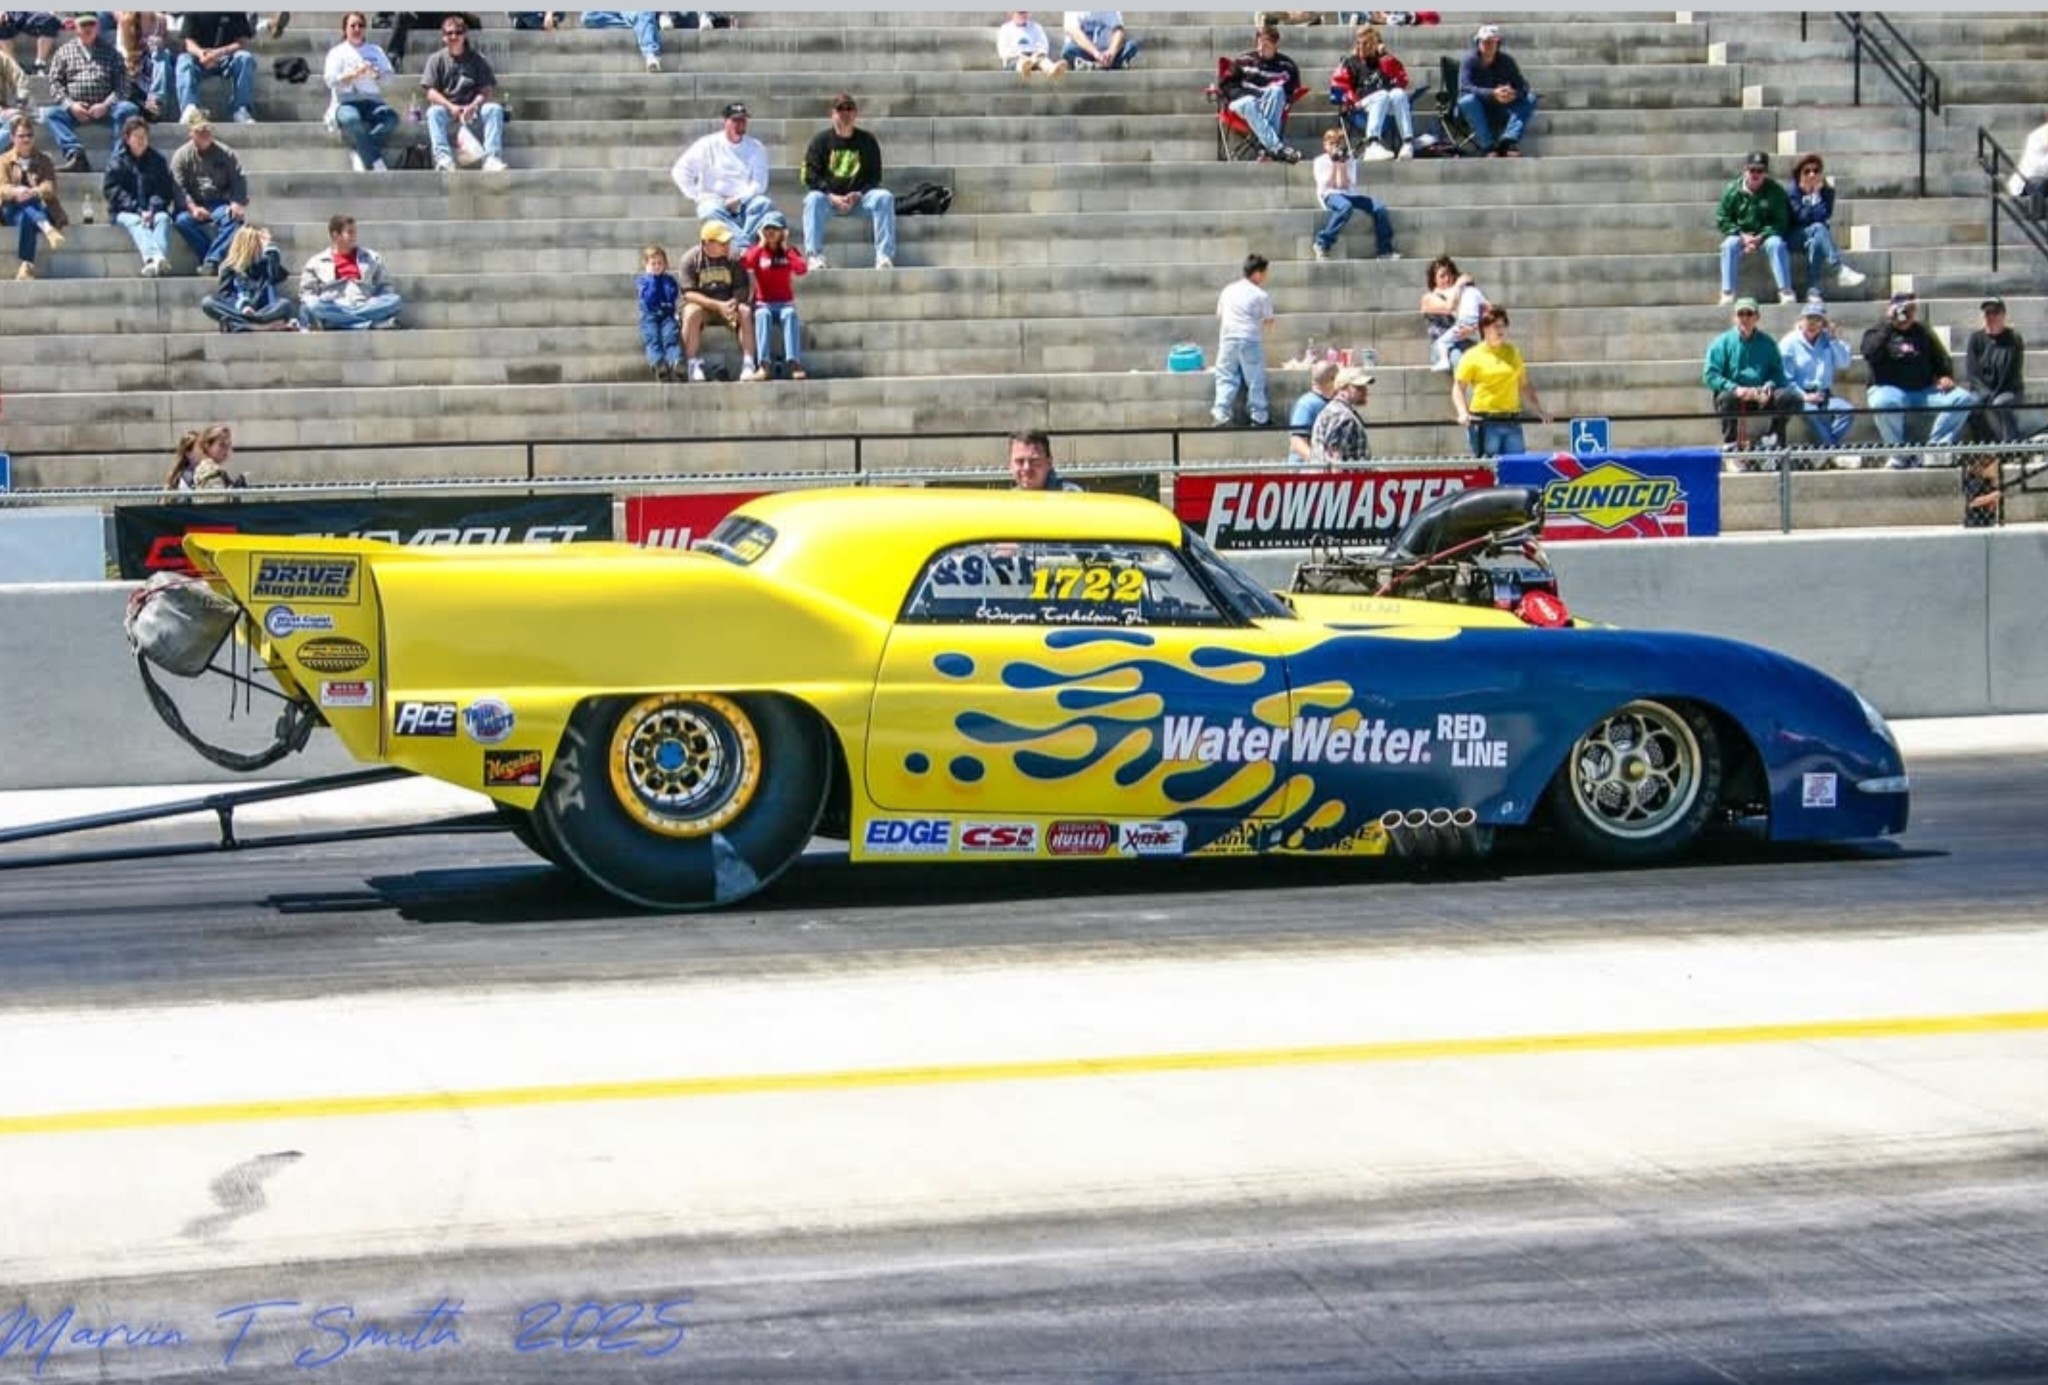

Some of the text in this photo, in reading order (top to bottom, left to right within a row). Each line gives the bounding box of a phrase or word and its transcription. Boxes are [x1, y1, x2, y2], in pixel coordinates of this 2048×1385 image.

[1546, 483, 1670, 509] SUNOCO
[1031, 566, 1144, 601] 1722
[1437, 714, 1487, 740] RED
[1452, 742, 1508, 767] LINE
[866, 820, 952, 844] EDGE
